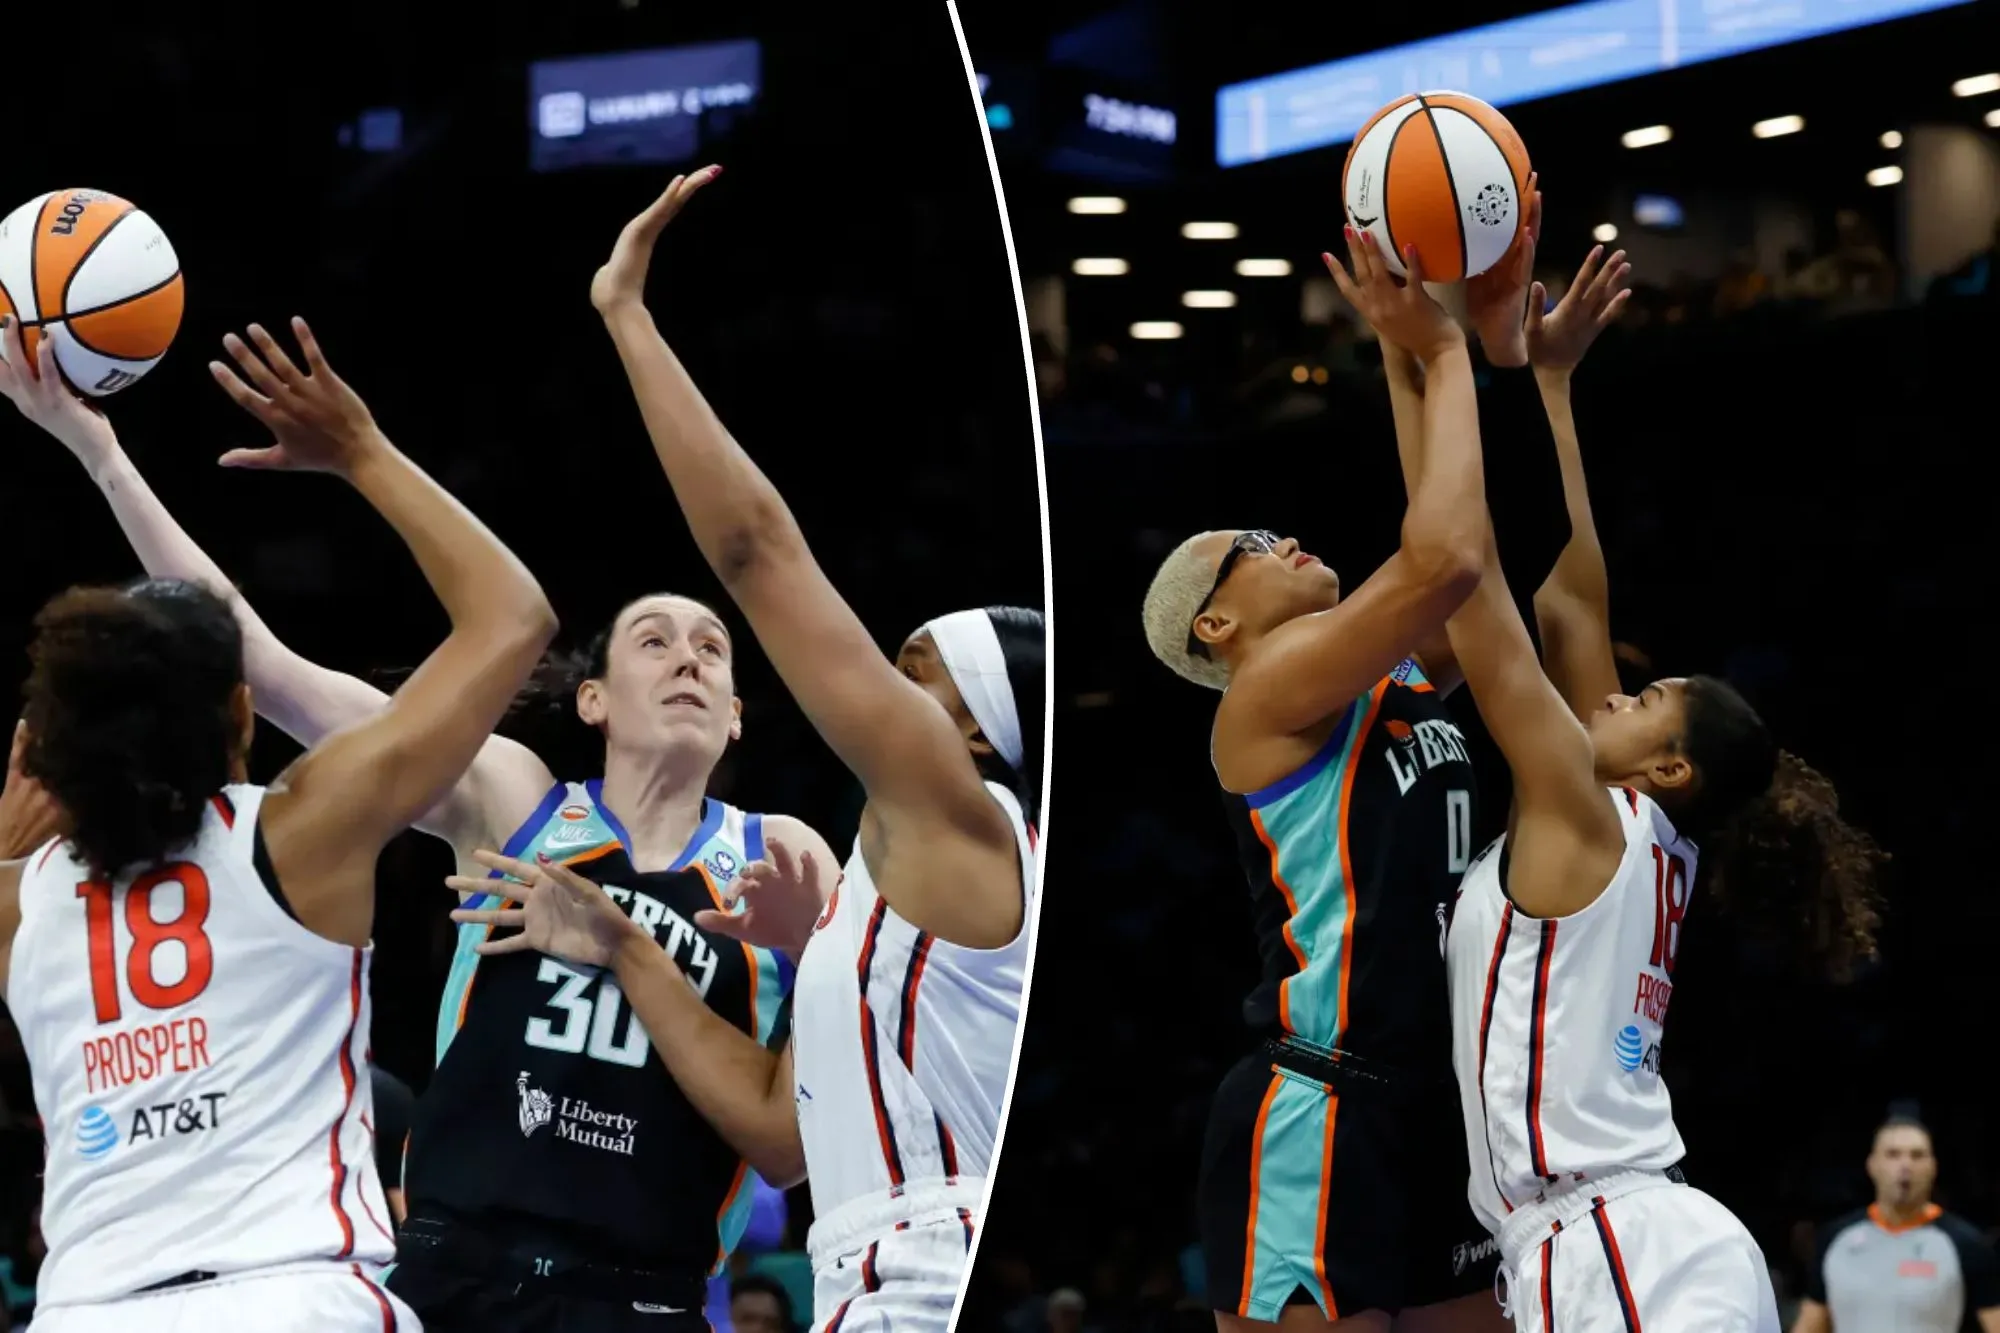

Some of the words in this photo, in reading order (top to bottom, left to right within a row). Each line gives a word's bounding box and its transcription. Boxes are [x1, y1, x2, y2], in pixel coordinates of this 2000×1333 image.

[554, 823, 596, 842] NIKE
[1650, 843, 1687, 971] 18
[76, 860, 213, 1024] 18
[525, 958, 650, 1068] 30
[84, 1016, 210, 1094] PROSPER
[127, 1091, 227, 1146] AT&T
[554, 1120, 635, 1156] Mutual
[559, 1097, 638, 1136] Liberty
